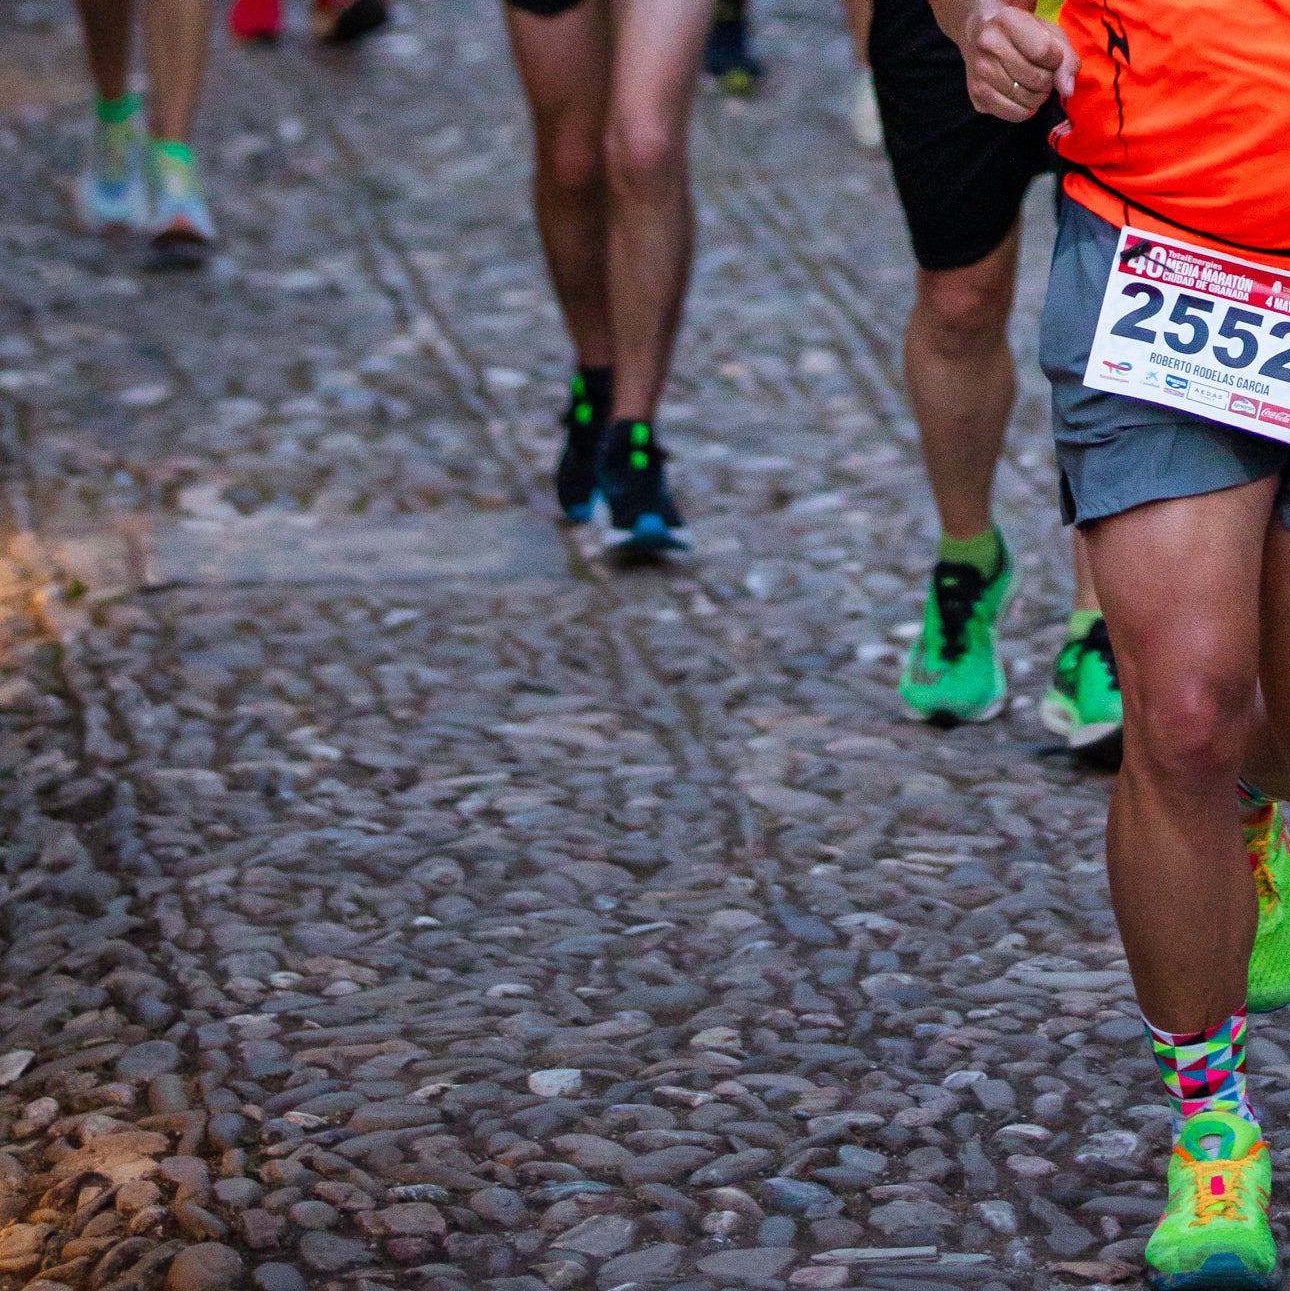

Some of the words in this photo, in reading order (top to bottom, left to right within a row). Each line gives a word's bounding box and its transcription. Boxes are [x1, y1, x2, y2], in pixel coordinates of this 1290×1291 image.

[1164, 257, 1200, 279] MEDIA
[1200, 267, 1254, 293] MARATÓN
[1167, 249, 1223, 271] TotalEnergies
[1161, 270, 1195, 288] CIUDAD
[1195, 280, 1209, 291] DE
[1208, 283, 1250, 302] GRANADA
[1265, 295, 1275, 308] 4
[1149, 351, 1192, 374] ROBERTO
[1192, 364, 1235, 387] RODELAS
[1236, 377, 1271, 397] GARCIA
